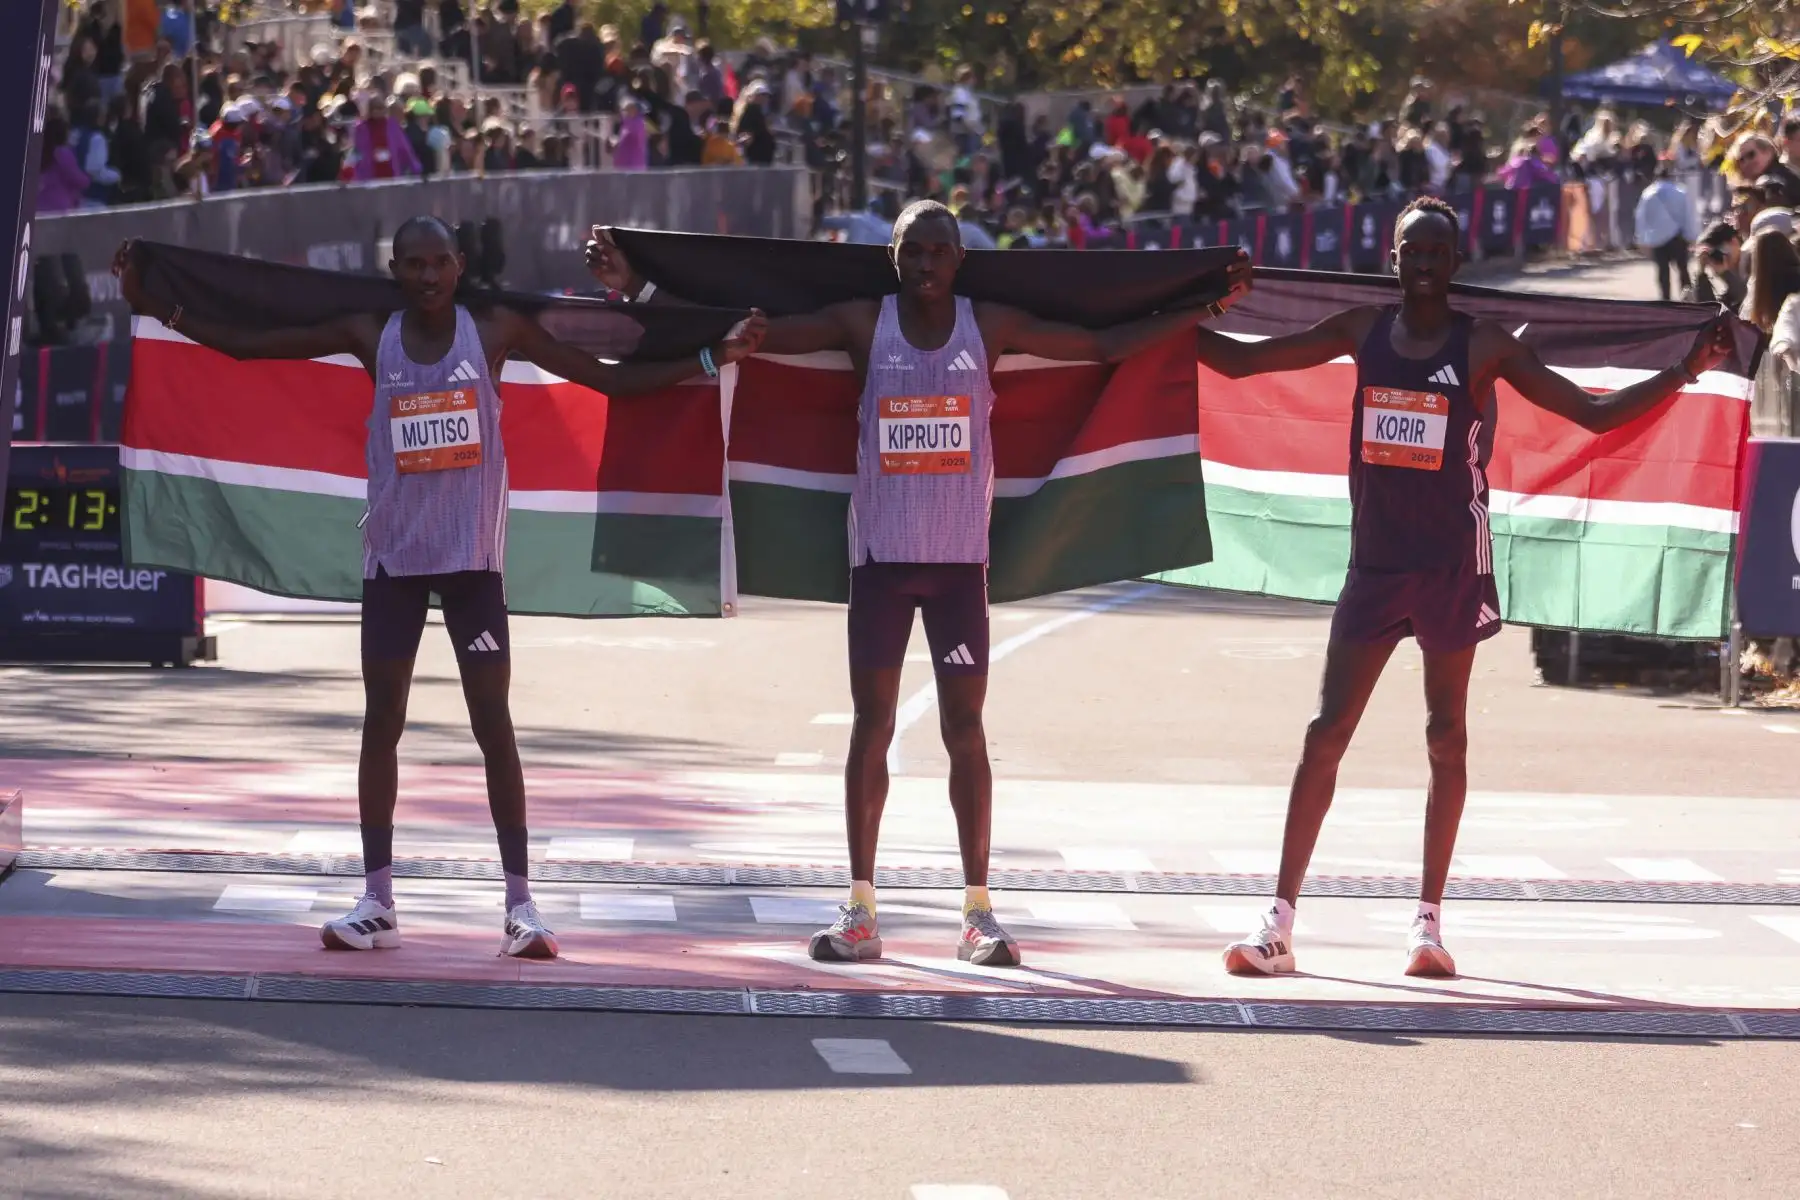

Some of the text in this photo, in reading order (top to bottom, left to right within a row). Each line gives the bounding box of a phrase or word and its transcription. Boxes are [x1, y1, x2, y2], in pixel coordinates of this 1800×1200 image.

[402, 416, 469, 449] MUTISO
[888, 423, 962, 449] KIPRUTO
[1375, 414, 1426, 444] KORIR
[940, 457, 966, 467] 2025
[1411, 452, 1437, 464] 2025
